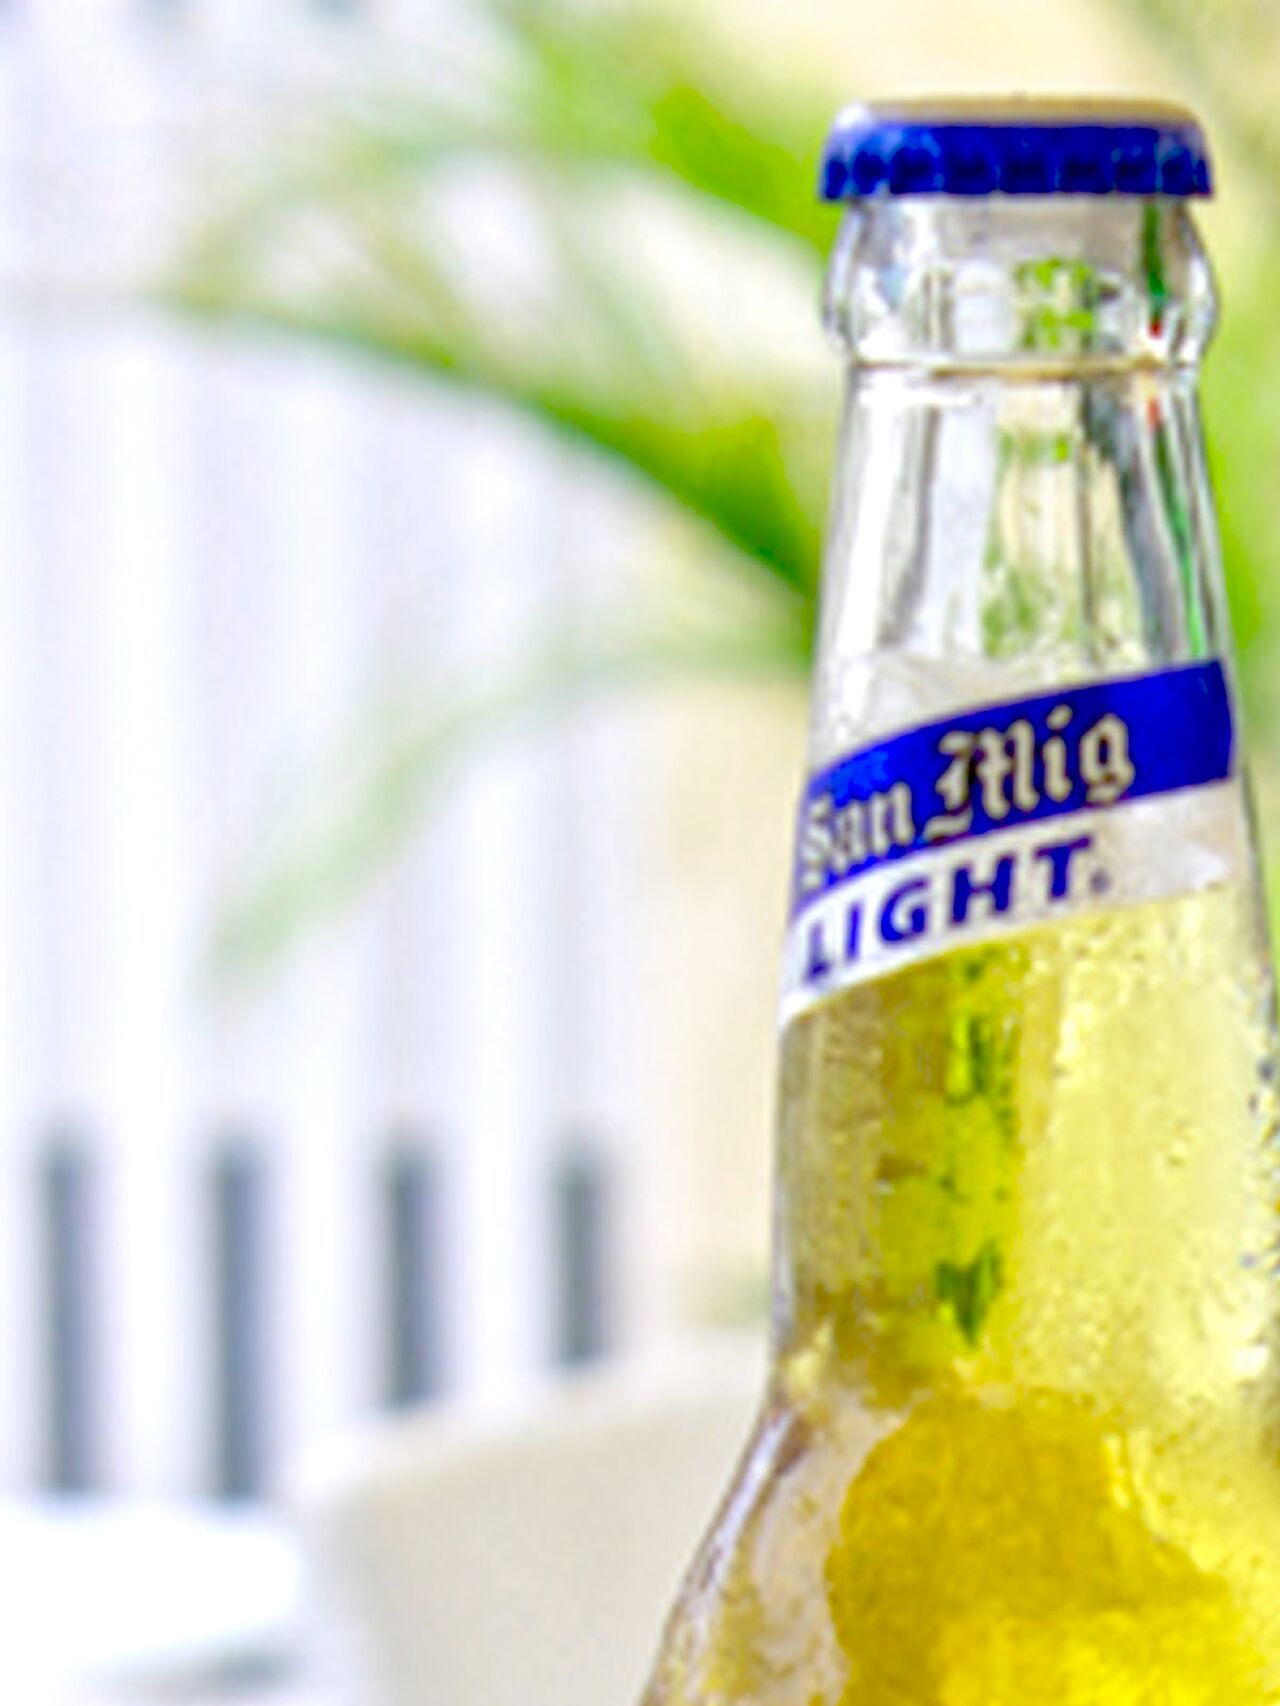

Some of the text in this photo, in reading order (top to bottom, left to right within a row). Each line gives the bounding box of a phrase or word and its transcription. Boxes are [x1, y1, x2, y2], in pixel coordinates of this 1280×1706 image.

[802, 702, 1136, 889] San Mig
[806, 835, 1094, 982] LIGHT
